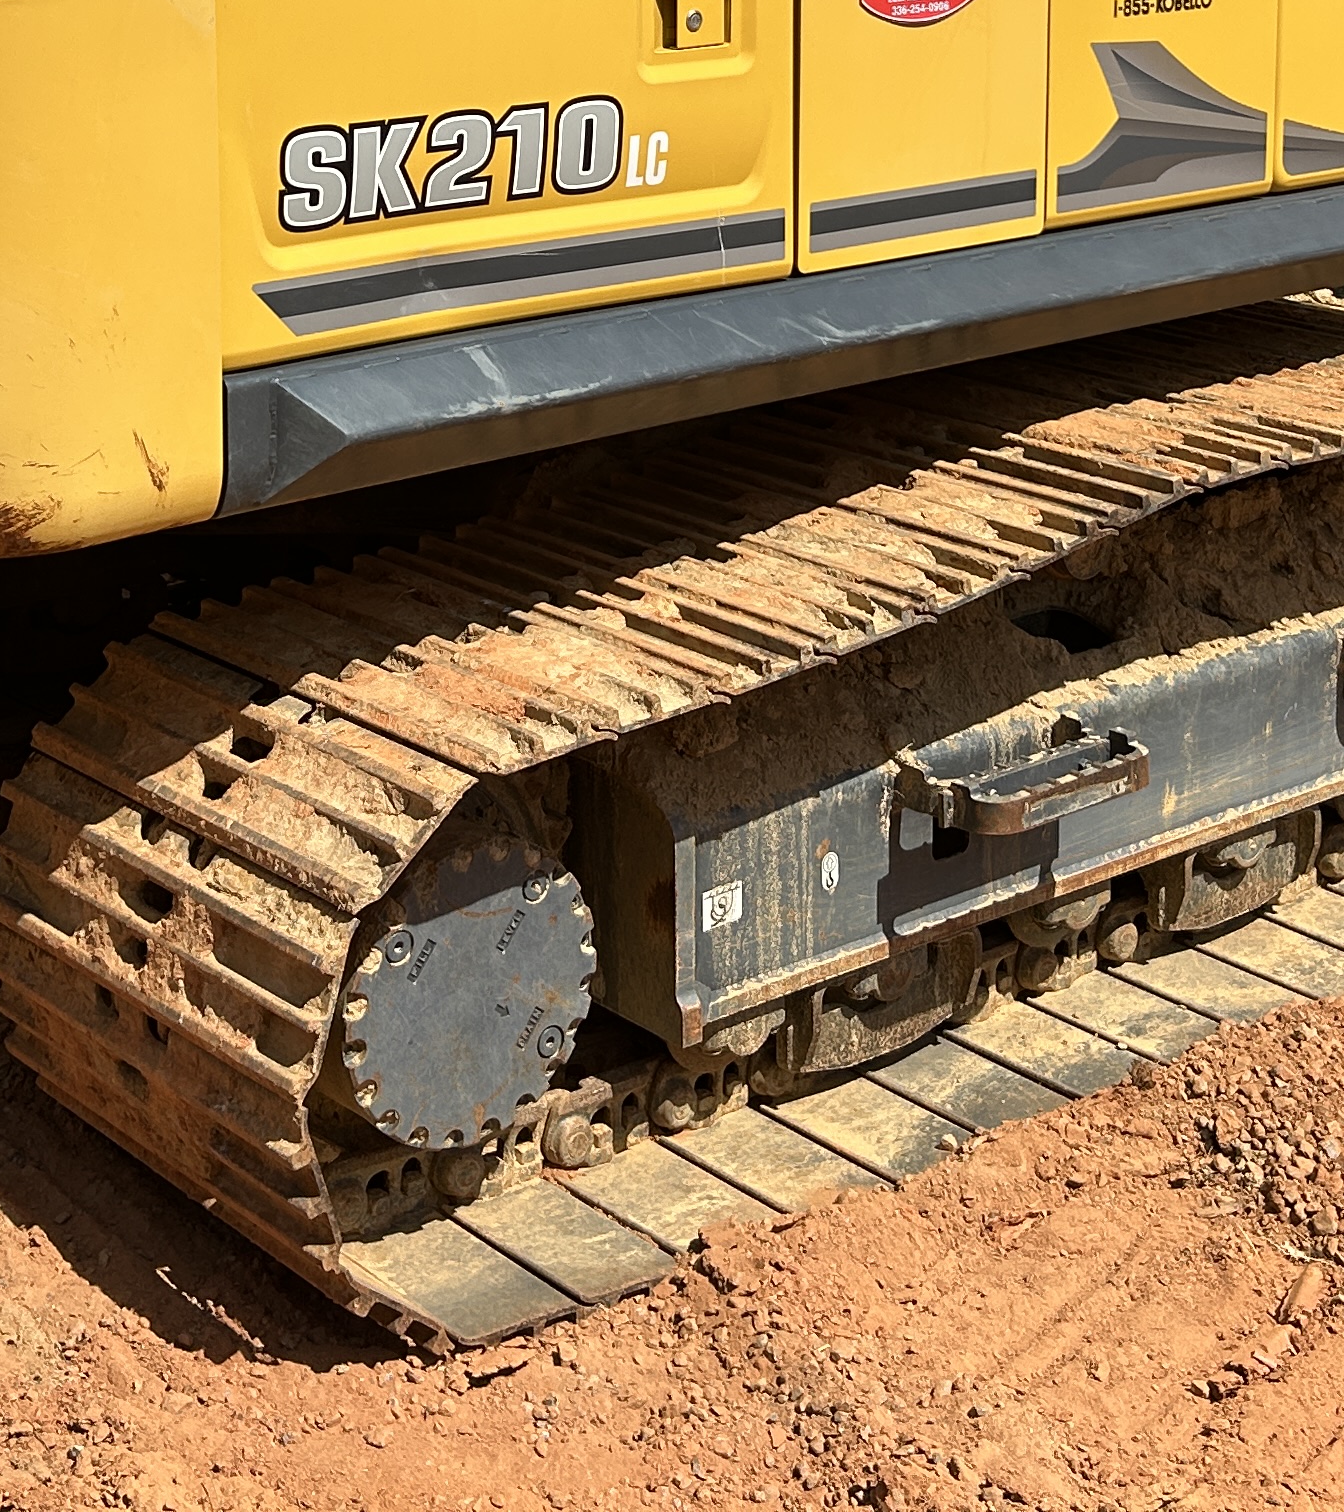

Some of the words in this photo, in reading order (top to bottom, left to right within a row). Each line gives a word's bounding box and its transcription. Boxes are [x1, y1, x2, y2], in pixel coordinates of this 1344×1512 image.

[278, 94, 624, 232] SK210
[625, 130, 670, 188] LC
[407, 939, 436, 982] FILL
[517, 1006, 544, 1049] DRAIN
